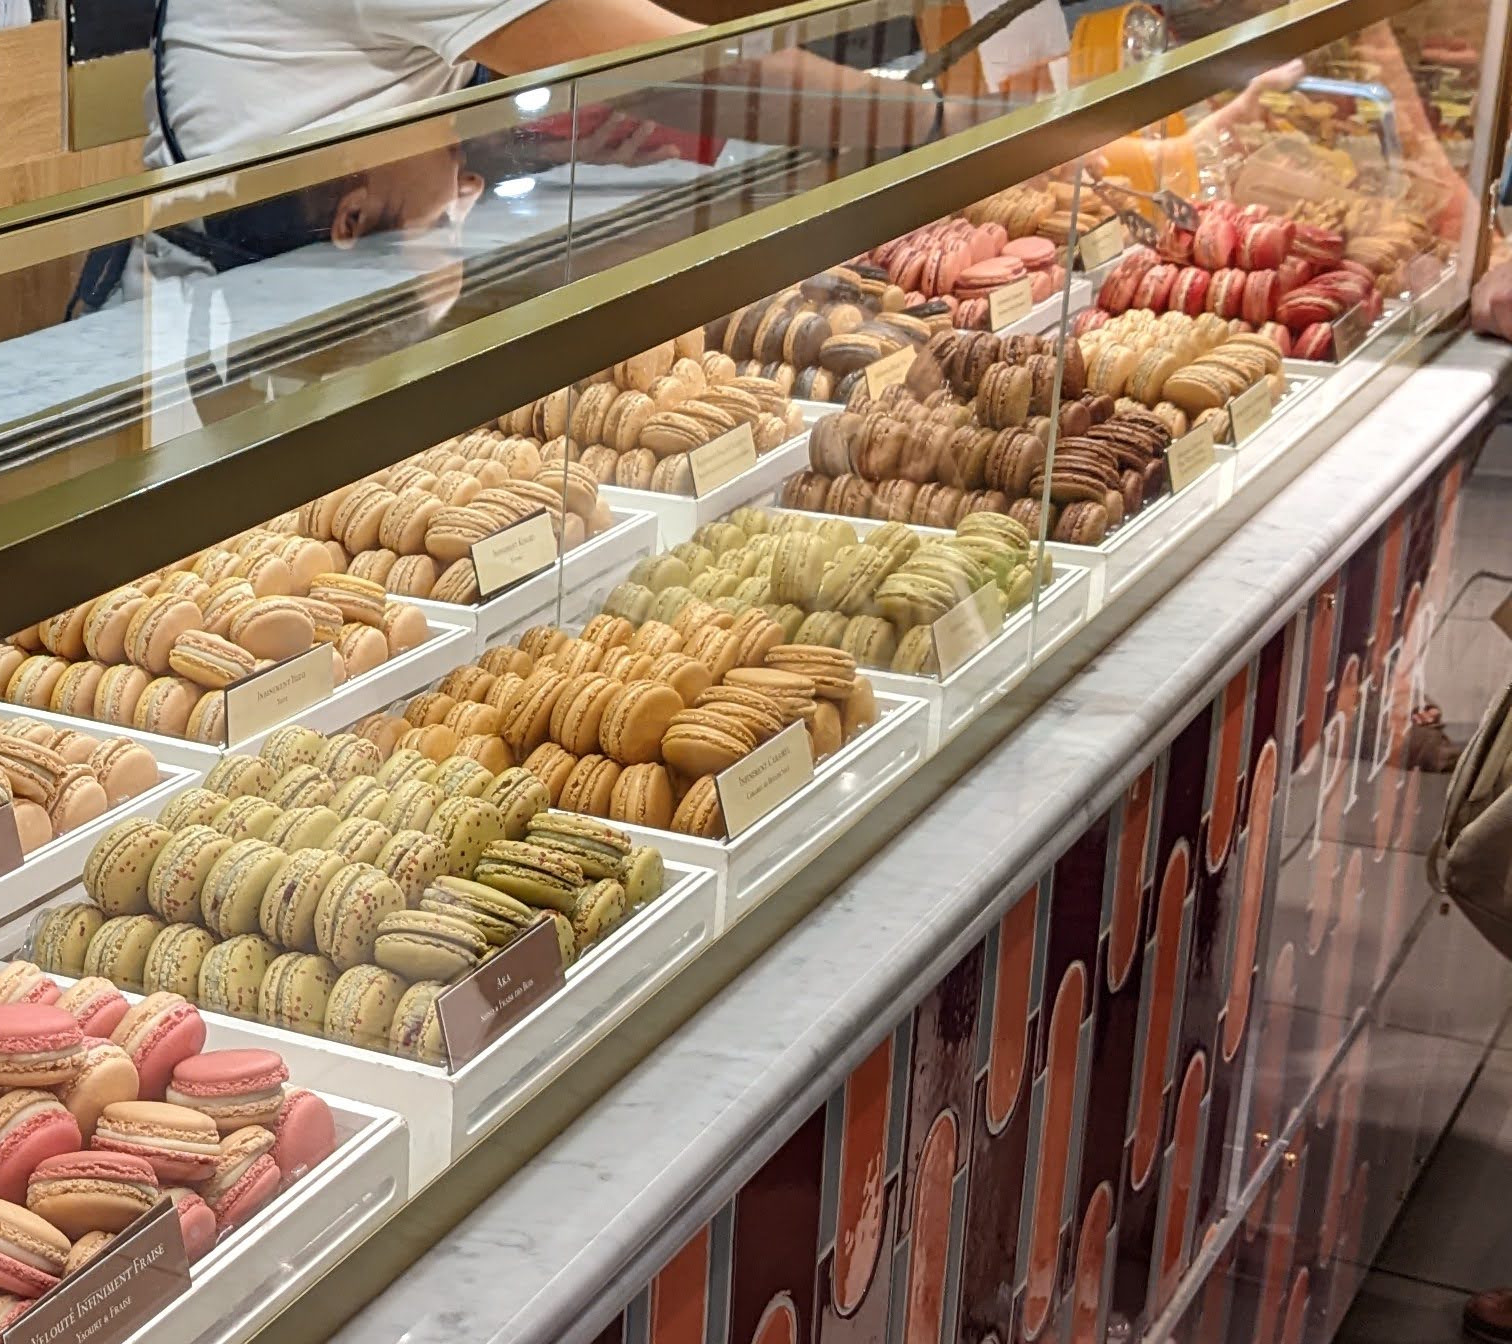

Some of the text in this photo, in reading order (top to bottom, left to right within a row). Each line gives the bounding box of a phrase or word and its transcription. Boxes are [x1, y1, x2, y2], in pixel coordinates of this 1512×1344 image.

[75, 1265, 133, 1318] INFINIMENT
[133, 1242, 165, 1274] FRAISE
[76, 1319, 102, 1344] YAOURT
[109, 1295, 133, 1318] FRAISE
